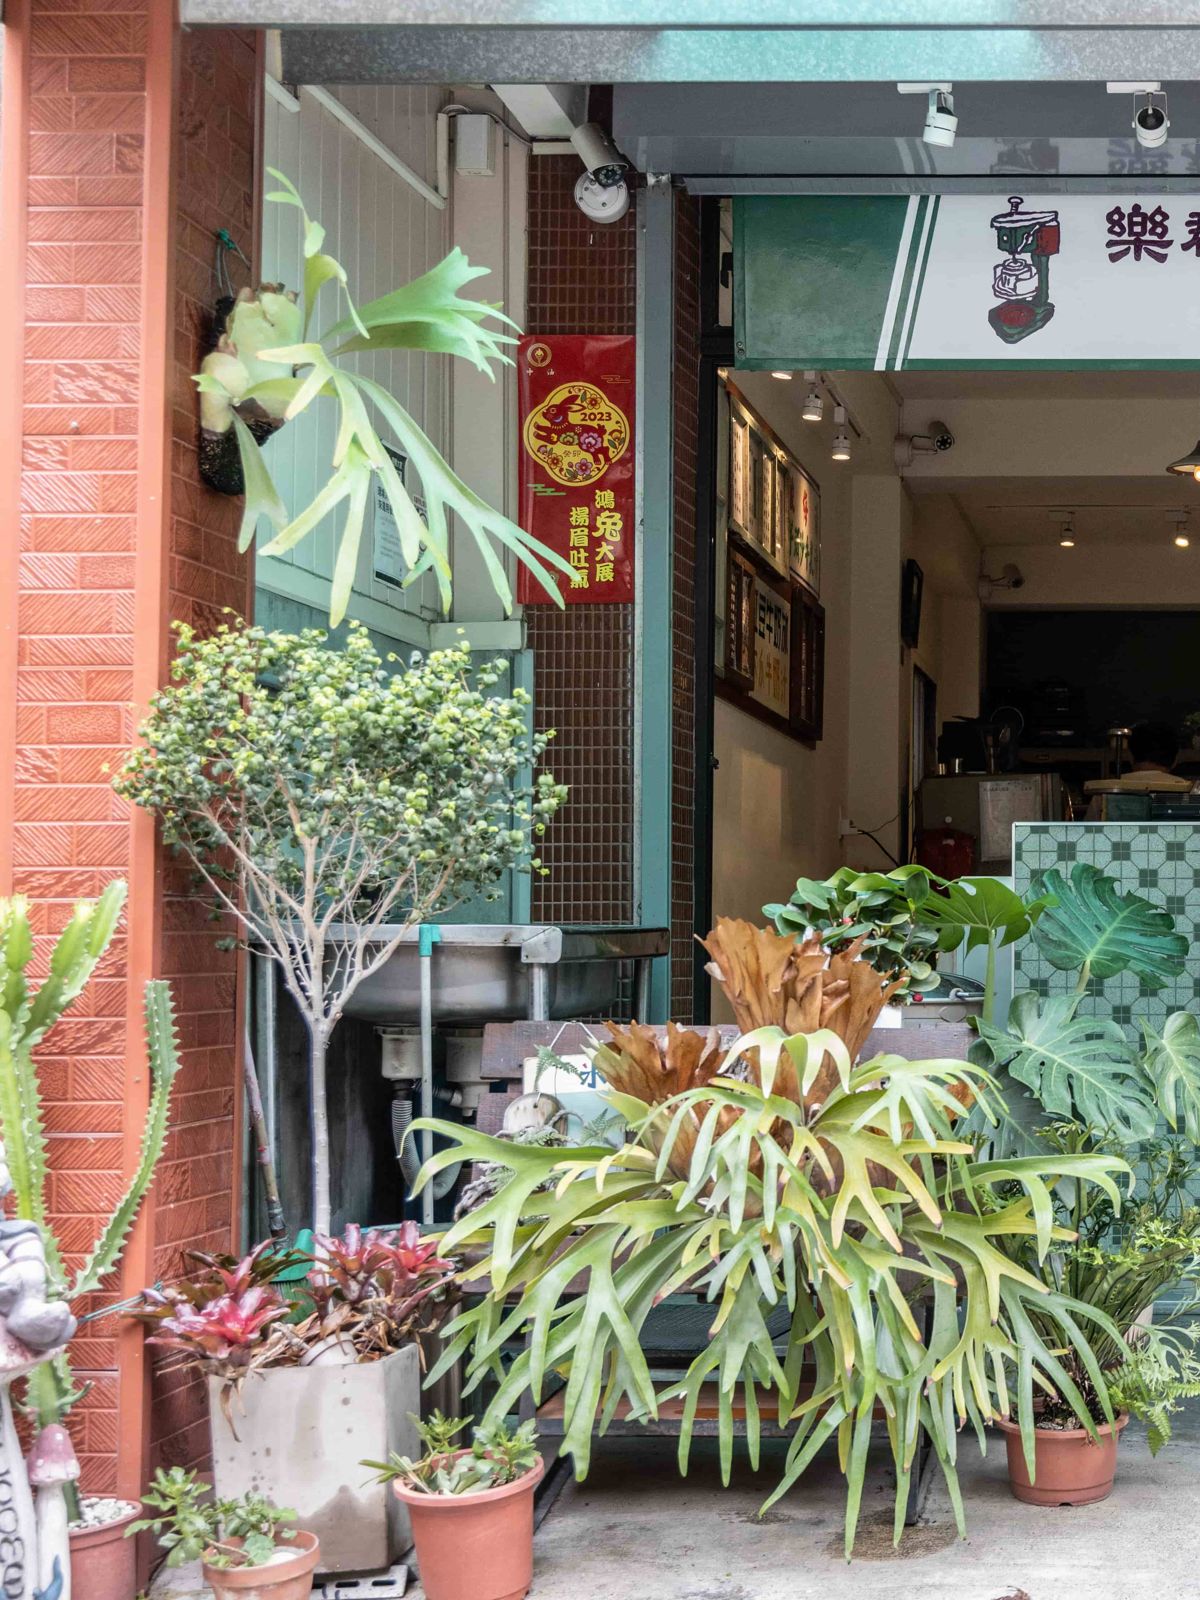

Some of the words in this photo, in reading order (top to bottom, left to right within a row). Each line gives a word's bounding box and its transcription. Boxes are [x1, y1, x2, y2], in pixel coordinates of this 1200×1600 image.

[580, 412, 612, 422] 2023
[592, 489, 623, 582] 鴻兔大展
